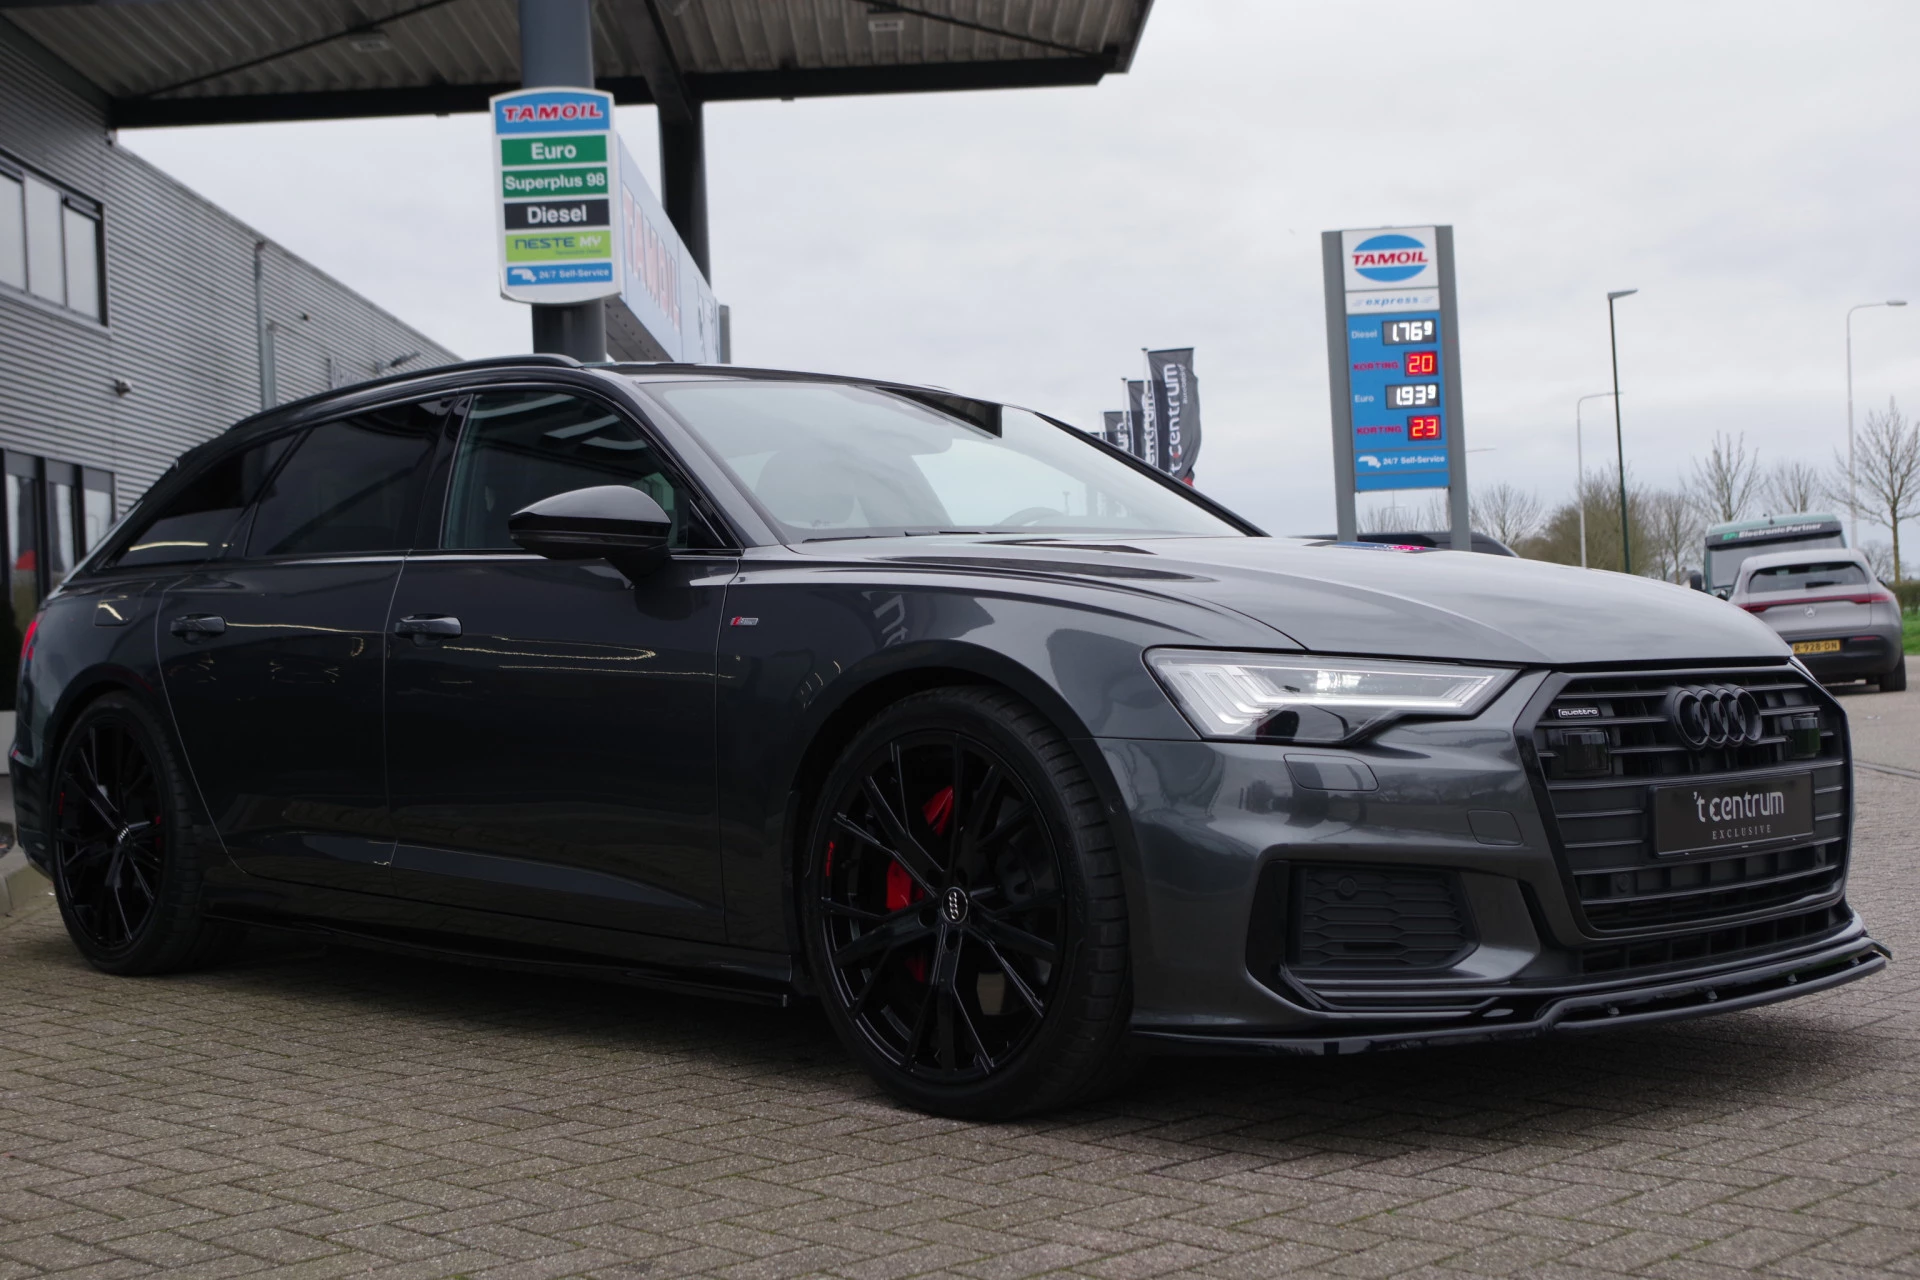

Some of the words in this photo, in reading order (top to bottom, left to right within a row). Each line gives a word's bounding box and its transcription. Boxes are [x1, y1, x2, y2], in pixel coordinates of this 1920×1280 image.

[503, 102, 603, 122] TAMOIL
[531, 143, 577, 160] Euro
[505, 174, 583, 192] Superplus
[586, 172, 605, 186] 98
[527, 204, 587, 224] Diesel
[1352, 251, 1429, 266] TAMOIL
[539, 271, 556, 279] 24/7
[559, 268, 609, 279] Self-Service
[1365, 296, 1419, 307] express
[1351, 330, 1378, 339] Diesel
[1353, 361, 1399, 370] KORTING
[1408, 354, 1433, 373] 20
[1355, 394, 1375, 403] Euro
[1163, 363, 1183, 458] centrum
[1357, 425, 1403, 435] KORTING
[1412, 418, 1437, 437] 23
[1383, 457, 1398, 465] 24/7
[1401, 455, 1445, 464] Self-Service
[1561, 708, 1598, 716] quattro
[1693, 791, 1706, 822] 't
[1709, 791, 1785, 822] centrum
[1712, 824, 1772, 840] EXCLUSIVE
